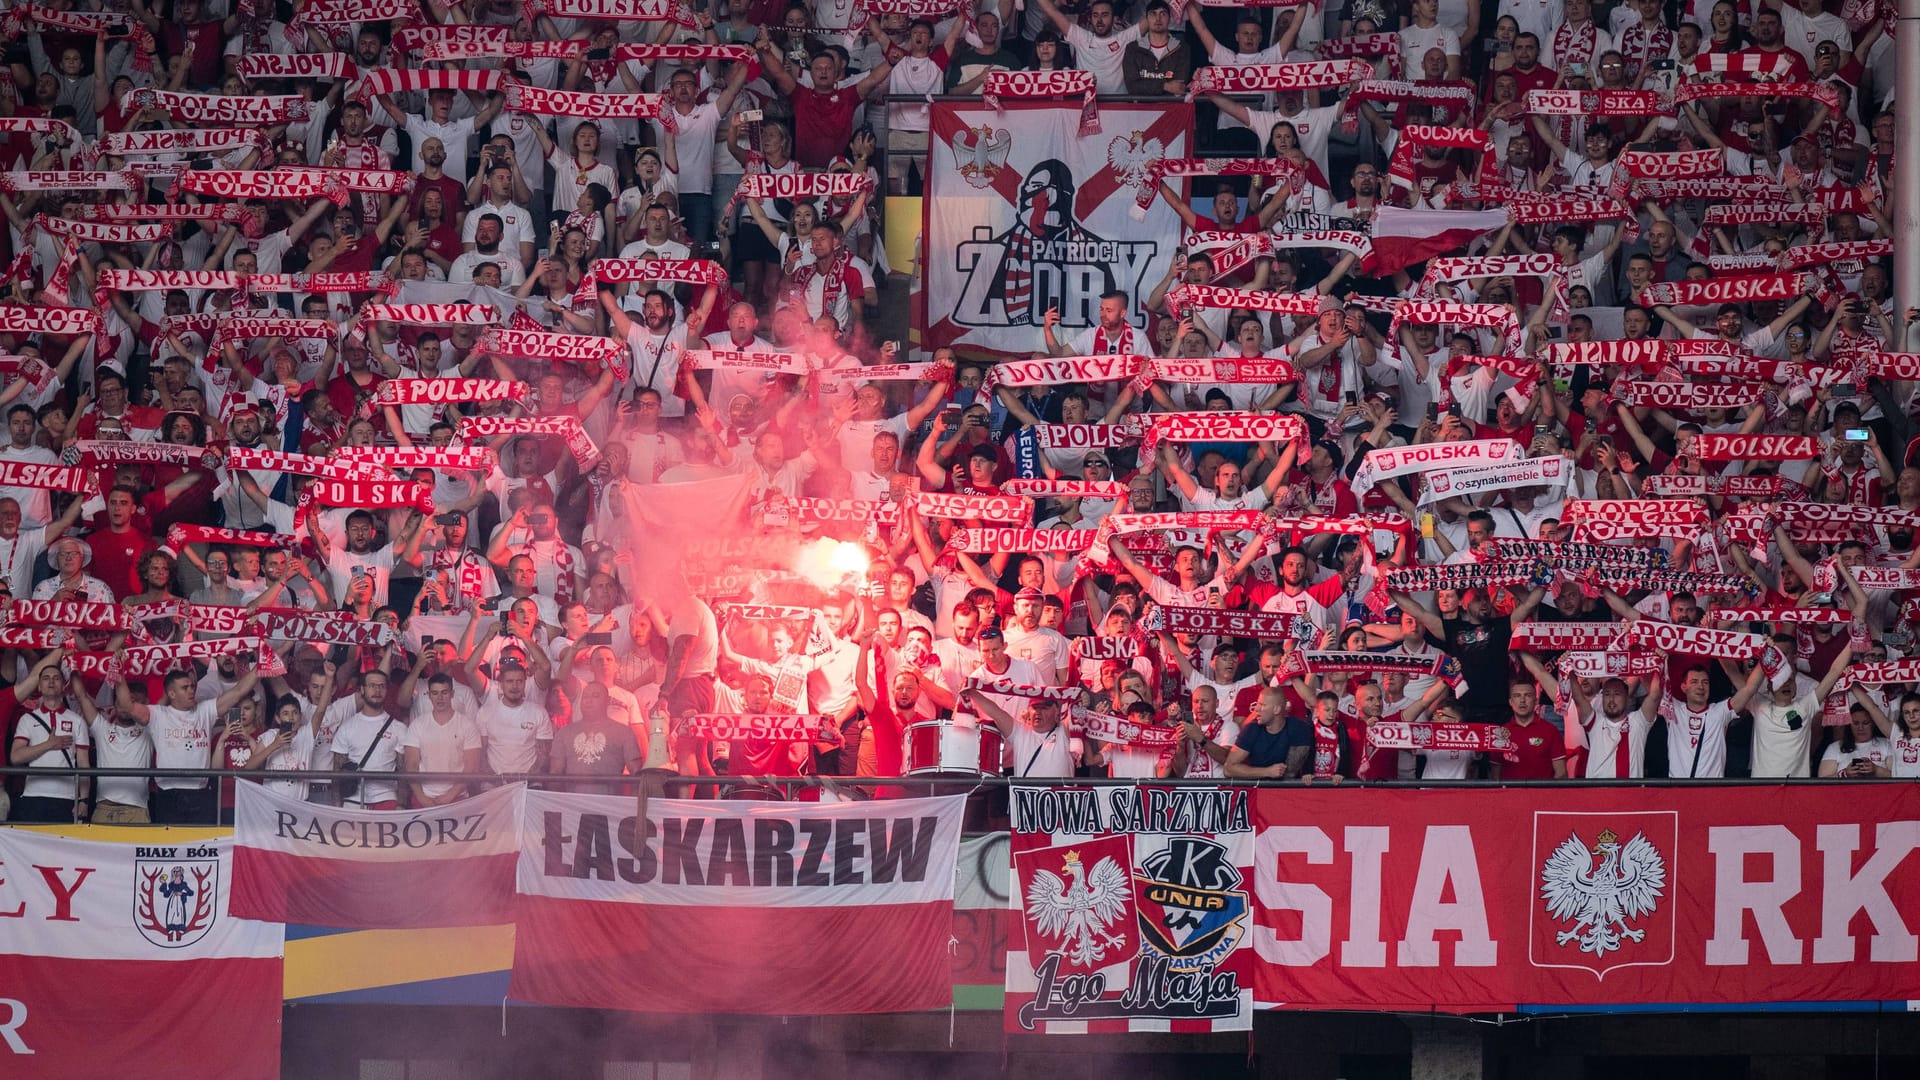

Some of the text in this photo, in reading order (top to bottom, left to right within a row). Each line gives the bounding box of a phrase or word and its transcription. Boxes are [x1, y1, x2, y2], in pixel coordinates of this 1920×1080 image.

[560, 0, 663, 16] POLSKA
[402, 26, 509, 46] POLSKA
[1224, 61, 1336, 90] POLSKA
[163, 94, 279, 122] POLSKA
[531, 91, 651, 118] POLSKA
[1537, 96, 1646, 110] POL SKA
[1406, 125, 1483, 145] POLSKA
[28, 173, 107, 182] POLSKA
[195, 174, 318, 197] POLSKA
[760, 175, 868, 196] POLSKA
[1519, 201, 1624, 218] POLSKA
[50, 219, 158, 241] POLSKA
[1031, 240, 1120, 263] PATRIOCI
[248, 271, 357, 287] POL SKA
[1688, 278, 1787, 299] POLSKA
[1196, 286, 1304, 312] POLSKA
[233, 319, 328, 338] POLSKA
[507, 331, 607, 358] POLSKA
[711, 351, 793, 365] POLSKA
[1167, 364, 1289, 380] POL SKA
[411, 380, 510, 402] POLSKA
[1634, 383, 1758, 409] POLSKA
[460, 417, 575, 437] POLSKA
[352, 448, 473, 466] POLSKA
[1402, 445, 1481, 465] POLSKA
[1713, 436, 1813, 457] POLSKA
[240, 451, 360, 480] POLSKA
[1013, 479, 1117, 495] POLSKA
[1464, 470, 1540, 490] szynakameble
[1659, 476, 1774, 490] POL SKA
[797, 499, 901, 523] POLSKA
[1197, 511, 1249, 525] SKA
[982, 529, 1083, 552] POLSKA
[1500, 541, 1647, 566] NOWA SARZYNA
[1387, 562, 1530, 586] NOWA SARZYNA
[1429, 578, 1490, 592] POLSKA
[1641, 580, 1698, 593] POLSKA
[19, 600, 118, 627] POLSKA
[1170, 612, 1286, 633] POLSKA
[267, 614, 383, 646] POLSKA
[1637, 621, 1753, 659] POLSKA
[1305, 655, 1434, 669] TARNOBRZEG
[695, 716, 810, 741] POLSKA
[1435, 728, 1480, 742] SKA
[1013, 788, 1252, 834] NOWA SARZYNA
[274, 810, 488, 850] RACIBÓRZ
[135, 844, 219, 858] BIAŁY BÓR
[541, 810, 939, 888] ŁASKARZEW
[1149, 842, 1236, 890] ZKS
[1149, 889, 1227, 909] UNIA
[1253, 825, 1498, 967] SIA
[1705, 820, 1920, 966] RK
[1121, 954, 1239, 1013] Maja
